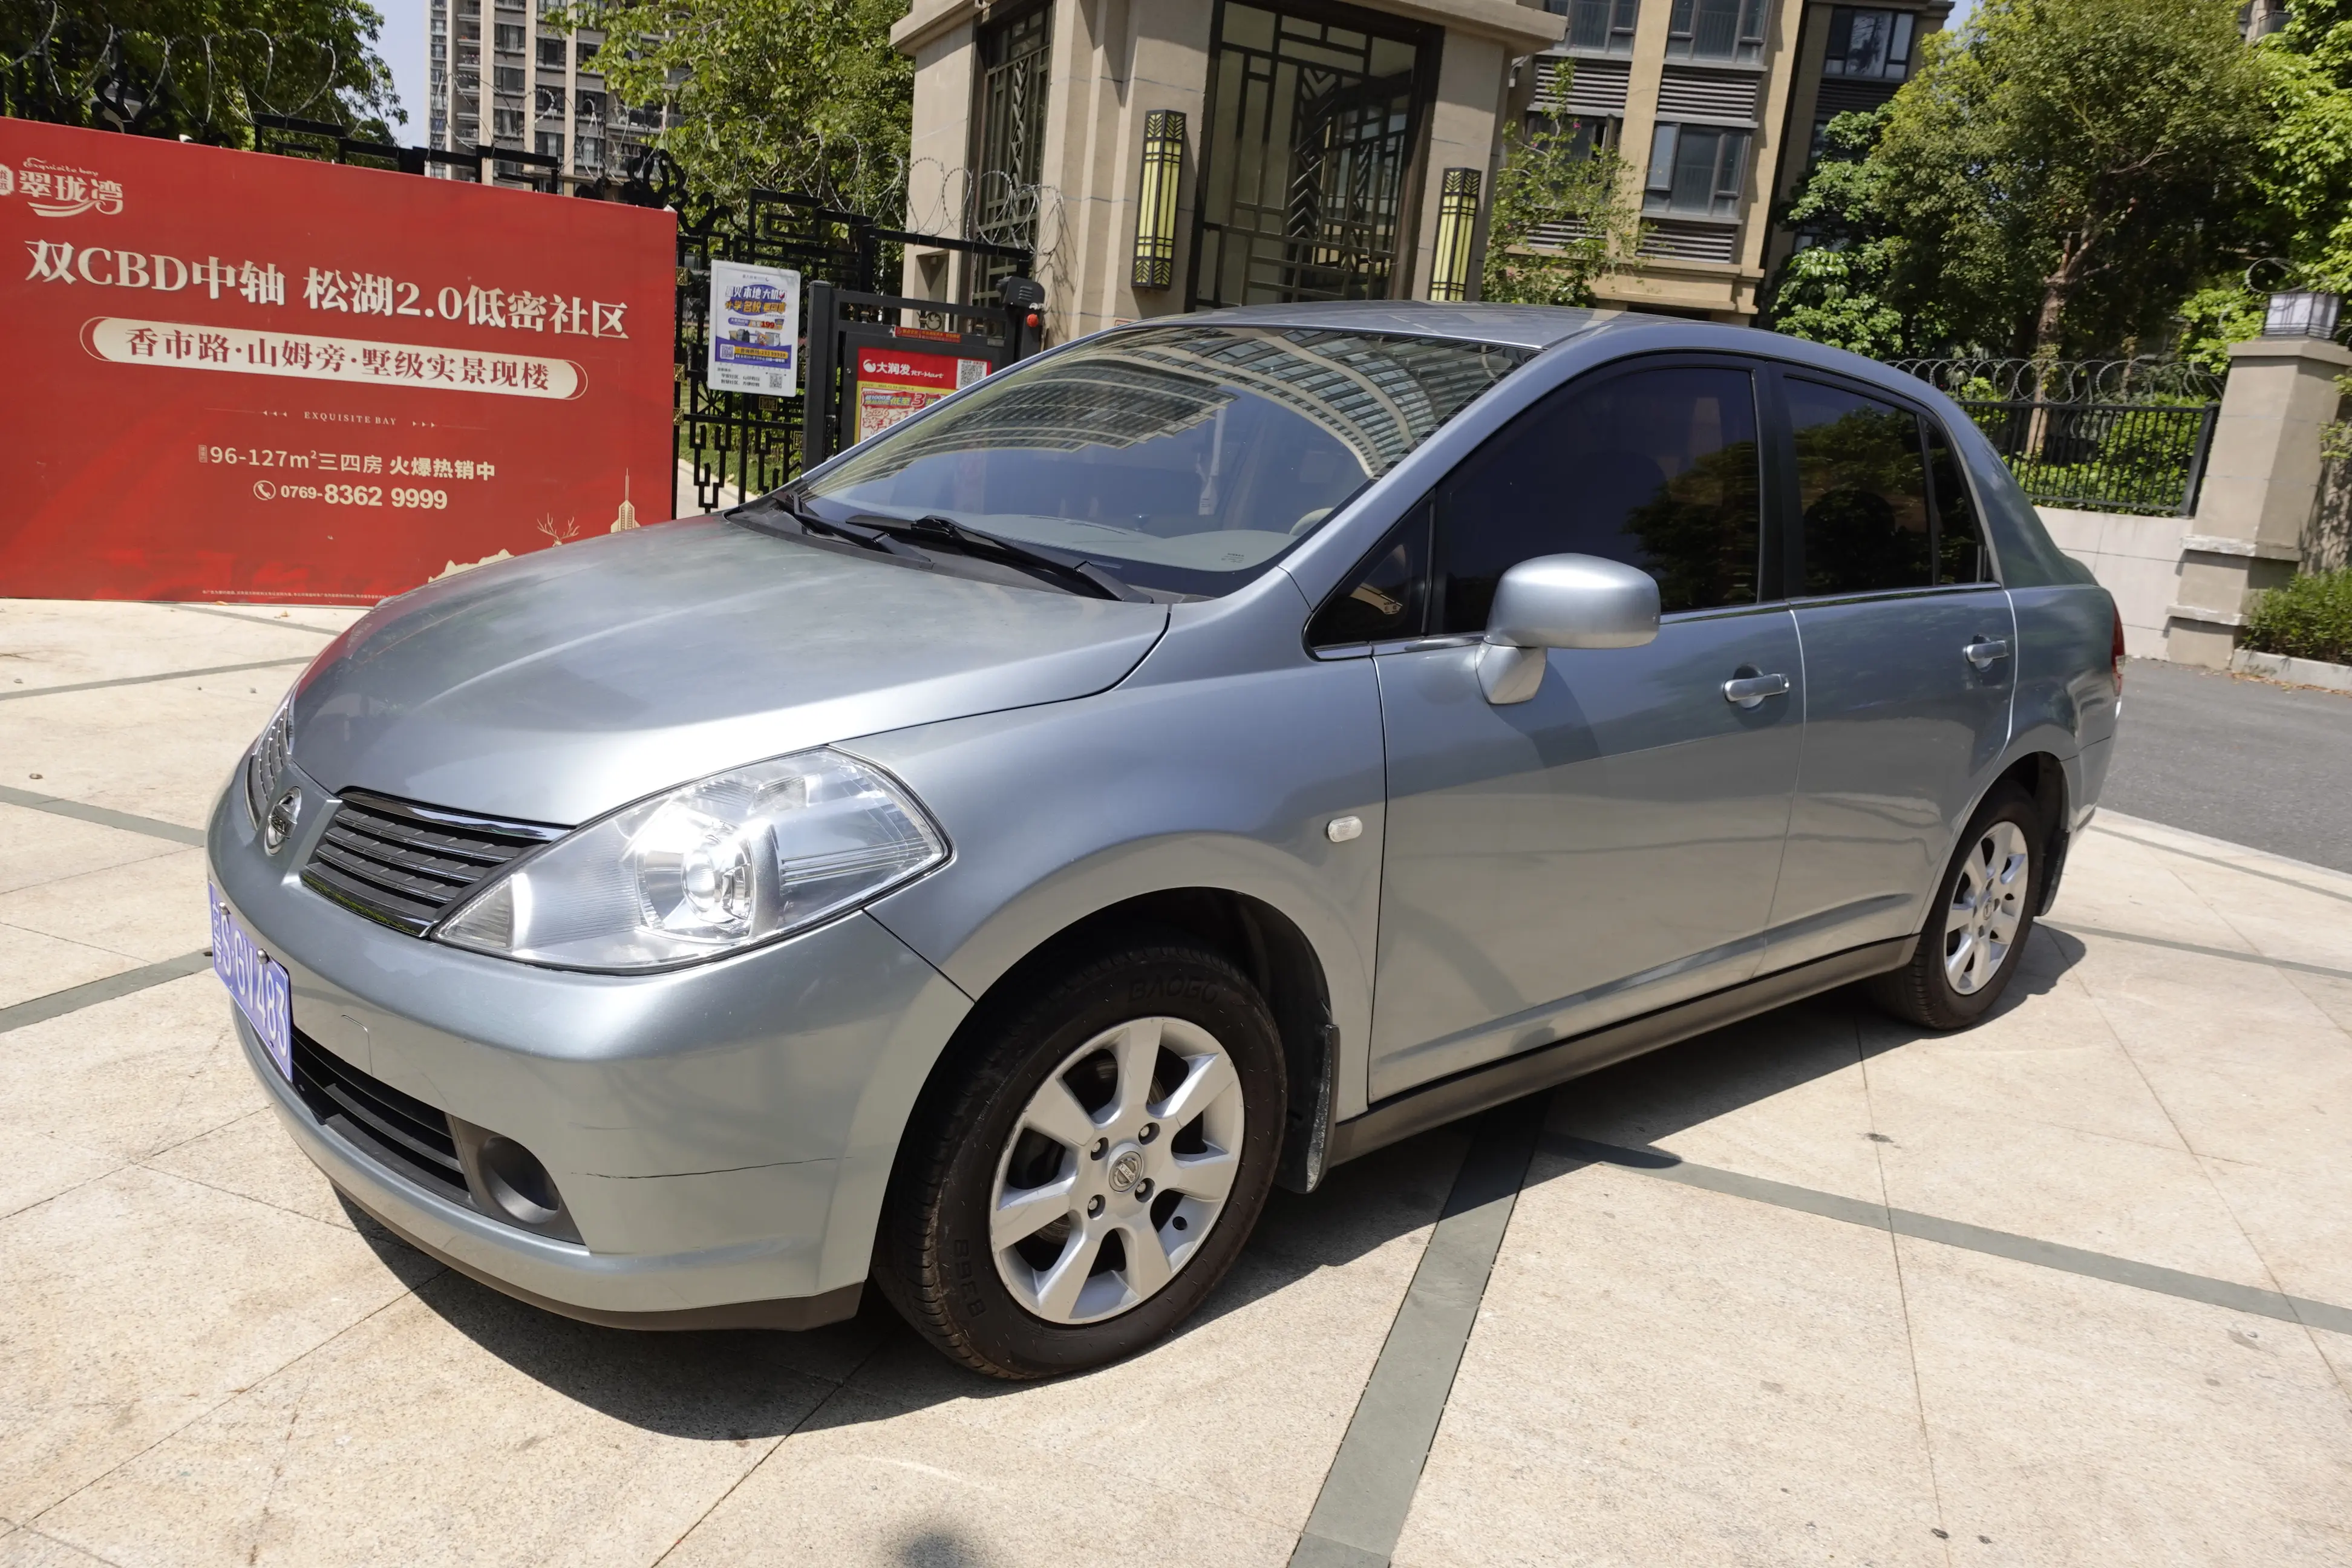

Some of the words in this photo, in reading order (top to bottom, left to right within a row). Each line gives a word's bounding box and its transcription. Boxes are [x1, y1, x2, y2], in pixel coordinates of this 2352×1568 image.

[19, 170, 124, 215] 翠珑湾
[25, 239, 286, 305] 双CBD中轴
[302, 266, 629, 340] 松湖2.0低密社区
[875, 362, 910, 376] 大润发
[304, 411, 371, 424] EXQUISITE
[375, 416, 397, 426] BAY
[389, 455, 495, 481] 火爆热销中
[280, 483, 383, 507] 0769-8362
[391, 487, 448, 510] 9999
